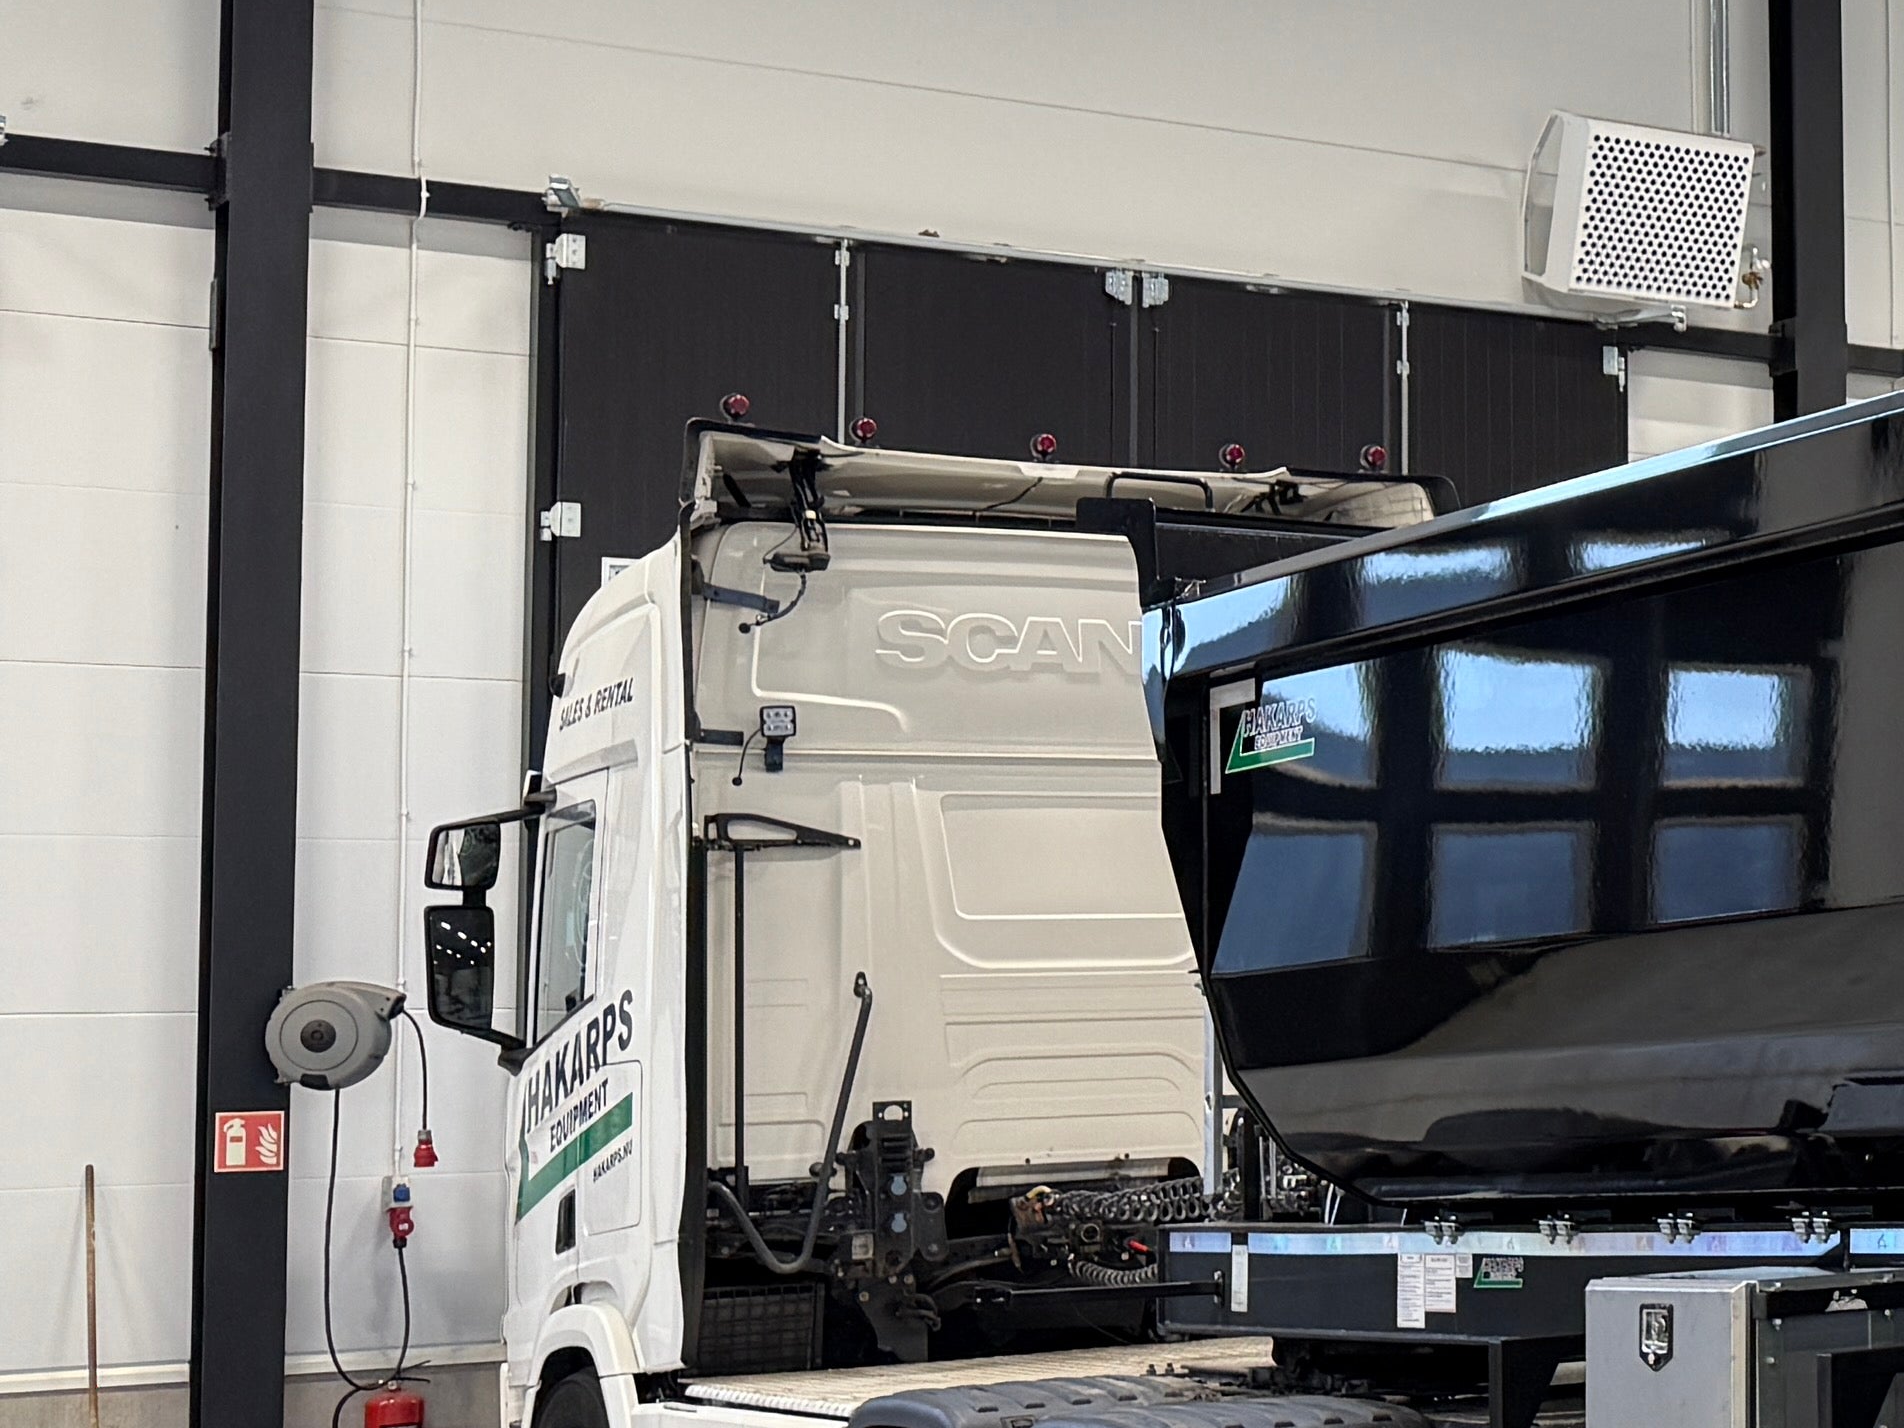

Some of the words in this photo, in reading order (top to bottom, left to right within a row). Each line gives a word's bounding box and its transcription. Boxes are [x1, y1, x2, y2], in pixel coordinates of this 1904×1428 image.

[875, 609, 1143, 674] SCAN
[559, 697, 584, 732] SALES
[594, 677, 634, 715] RENTAL
[1242, 697, 1318, 738] HAKARPS
[527, 989, 634, 1134] HAKARPS
[550, 1077, 609, 1153] EQUIPMENT
[593, 1138, 634, 1183] HAKARPS.NU
